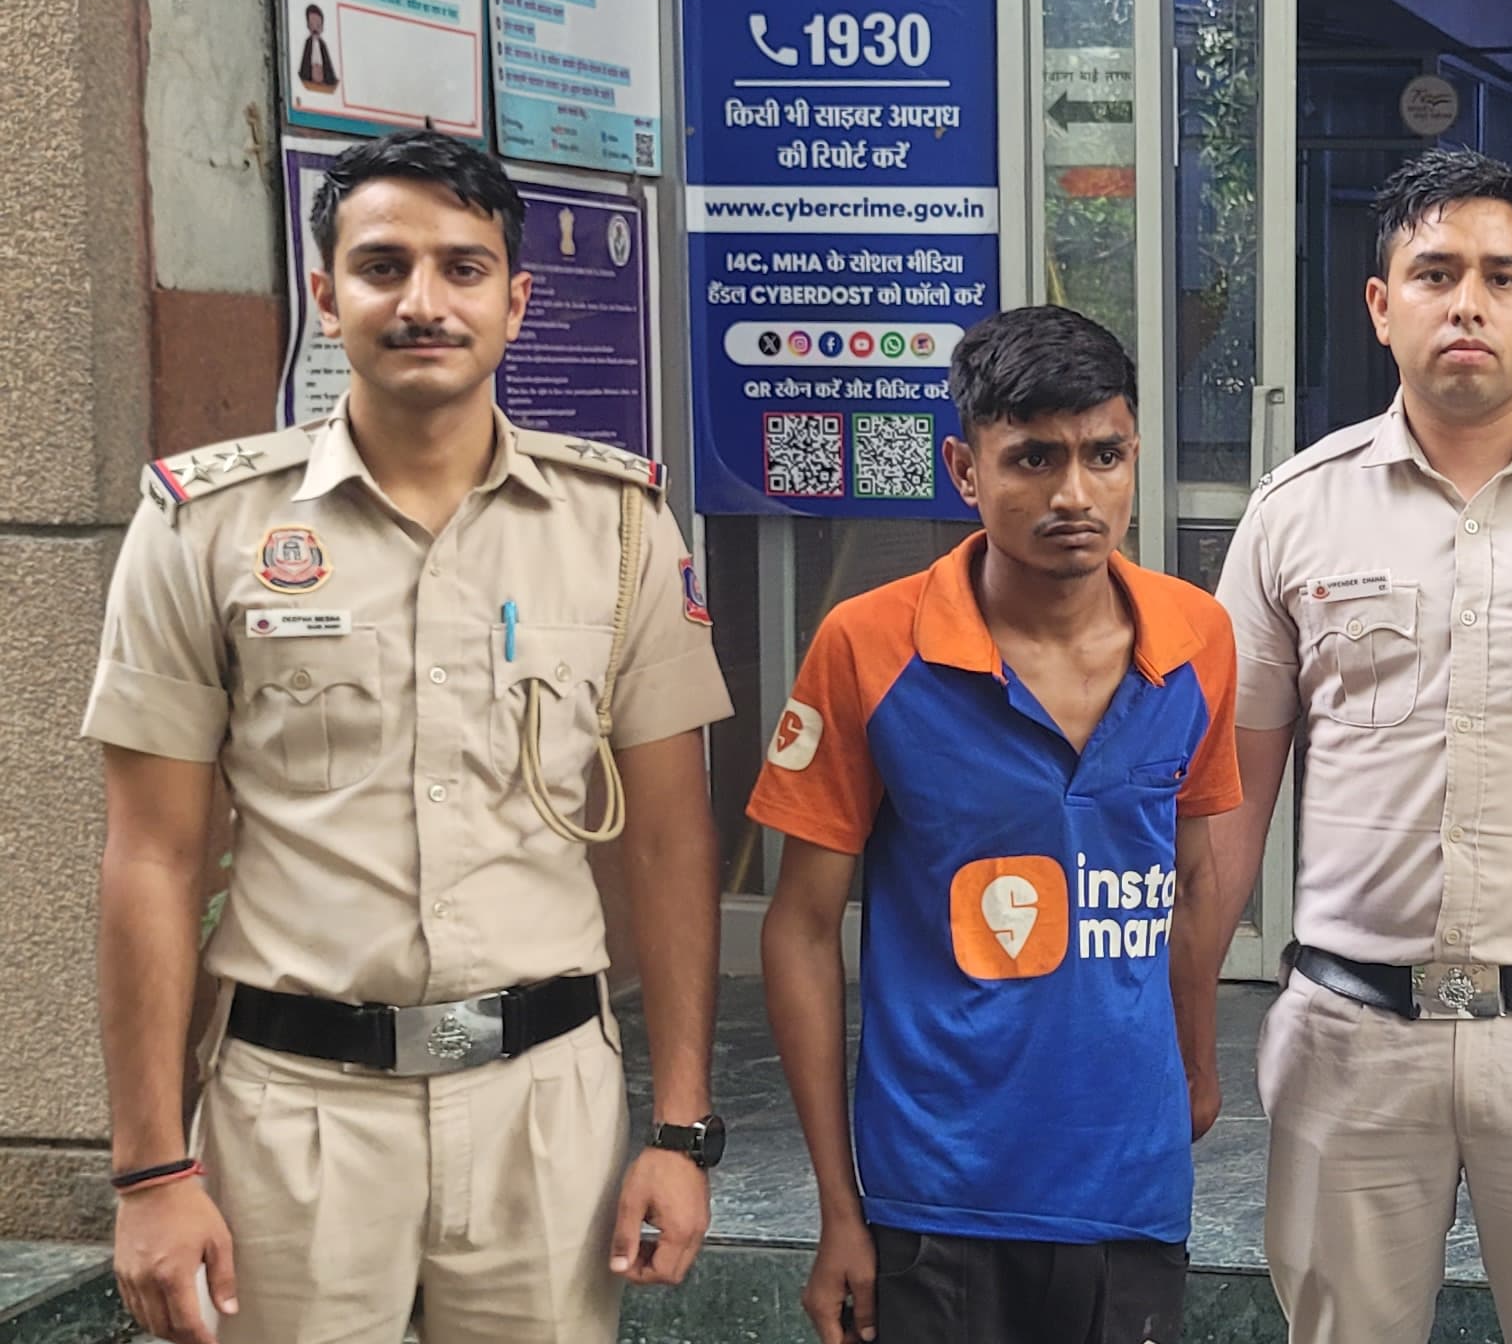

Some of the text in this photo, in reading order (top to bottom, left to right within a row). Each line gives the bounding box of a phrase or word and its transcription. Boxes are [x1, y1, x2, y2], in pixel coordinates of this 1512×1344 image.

[803, 11, 931, 67] 1930
[725, 97, 961, 131] किसी भी साइबर अपराध
[777, 139, 911, 169] की रिपोर्ट करें
[704, 197, 985, 223] www.cybercrime.gov.in
[772, 252, 824, 273] MHA
[827, 250, 846, 274] के
[850, 250, 904, 274] सोशल
[907, 249, 964, 274] मीडिया
[749, 285, 874, 305] CYBERDOST
[878, 282, 902, 306] को
[905, 282, 951, 306] फॉलो
[954, 282, 986, 306] करें
[743, 377, 921, 399] QR स्कैन करें और विजिट
